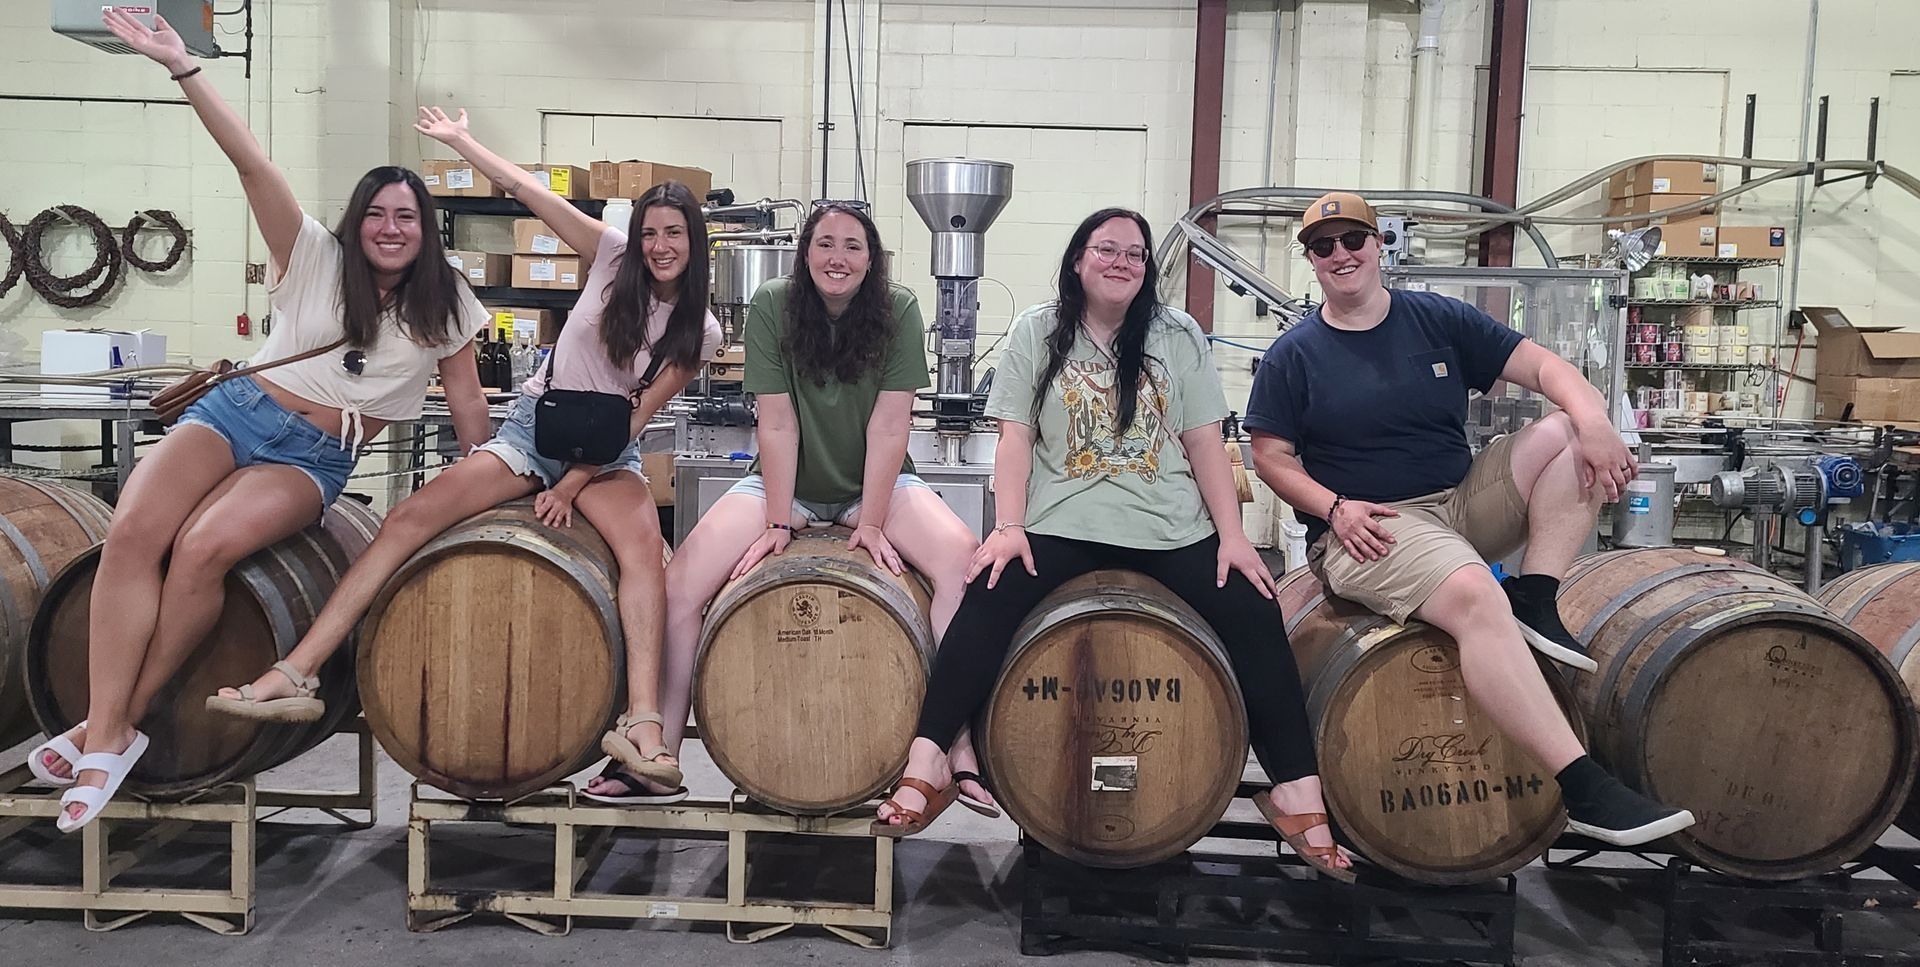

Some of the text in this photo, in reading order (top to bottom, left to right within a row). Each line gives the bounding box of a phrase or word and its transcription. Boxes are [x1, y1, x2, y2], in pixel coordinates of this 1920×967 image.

[1392, 733, 1494, 766] Dry Creek
[1394, 763, 1492, 776] VINEYARD
